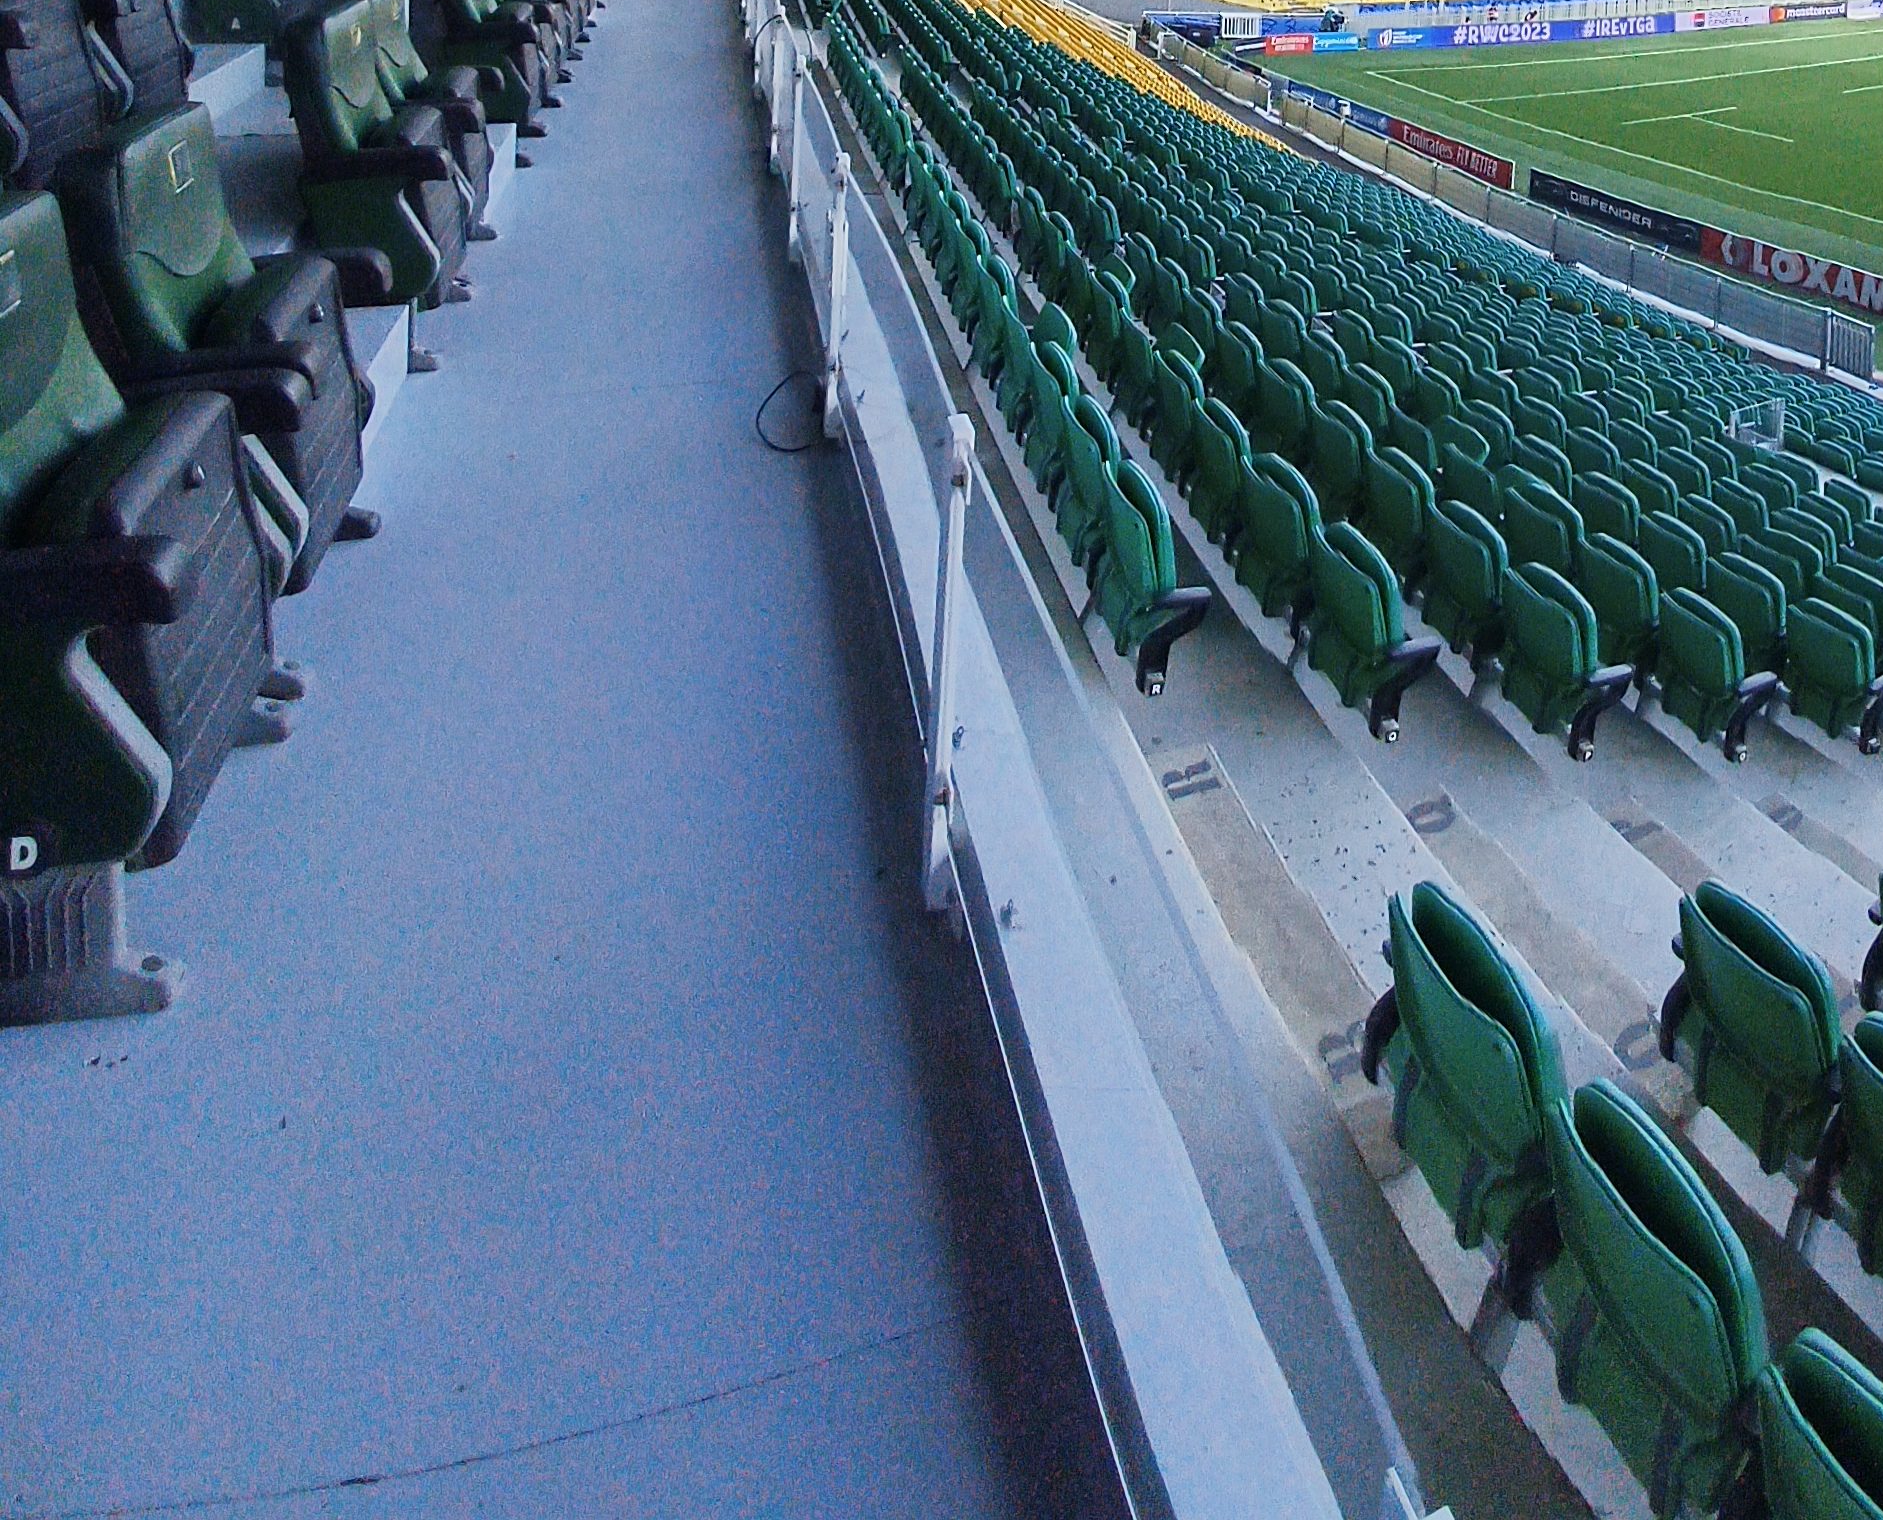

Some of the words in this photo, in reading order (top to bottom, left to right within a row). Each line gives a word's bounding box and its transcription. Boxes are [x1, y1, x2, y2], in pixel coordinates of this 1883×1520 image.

[1454, 22, 1550, 45] #RWC2023
[1403, 125, 1452, 160] Emirates
[1151, 683, 1162, 696] R
[10, 836, 38, 871] D
